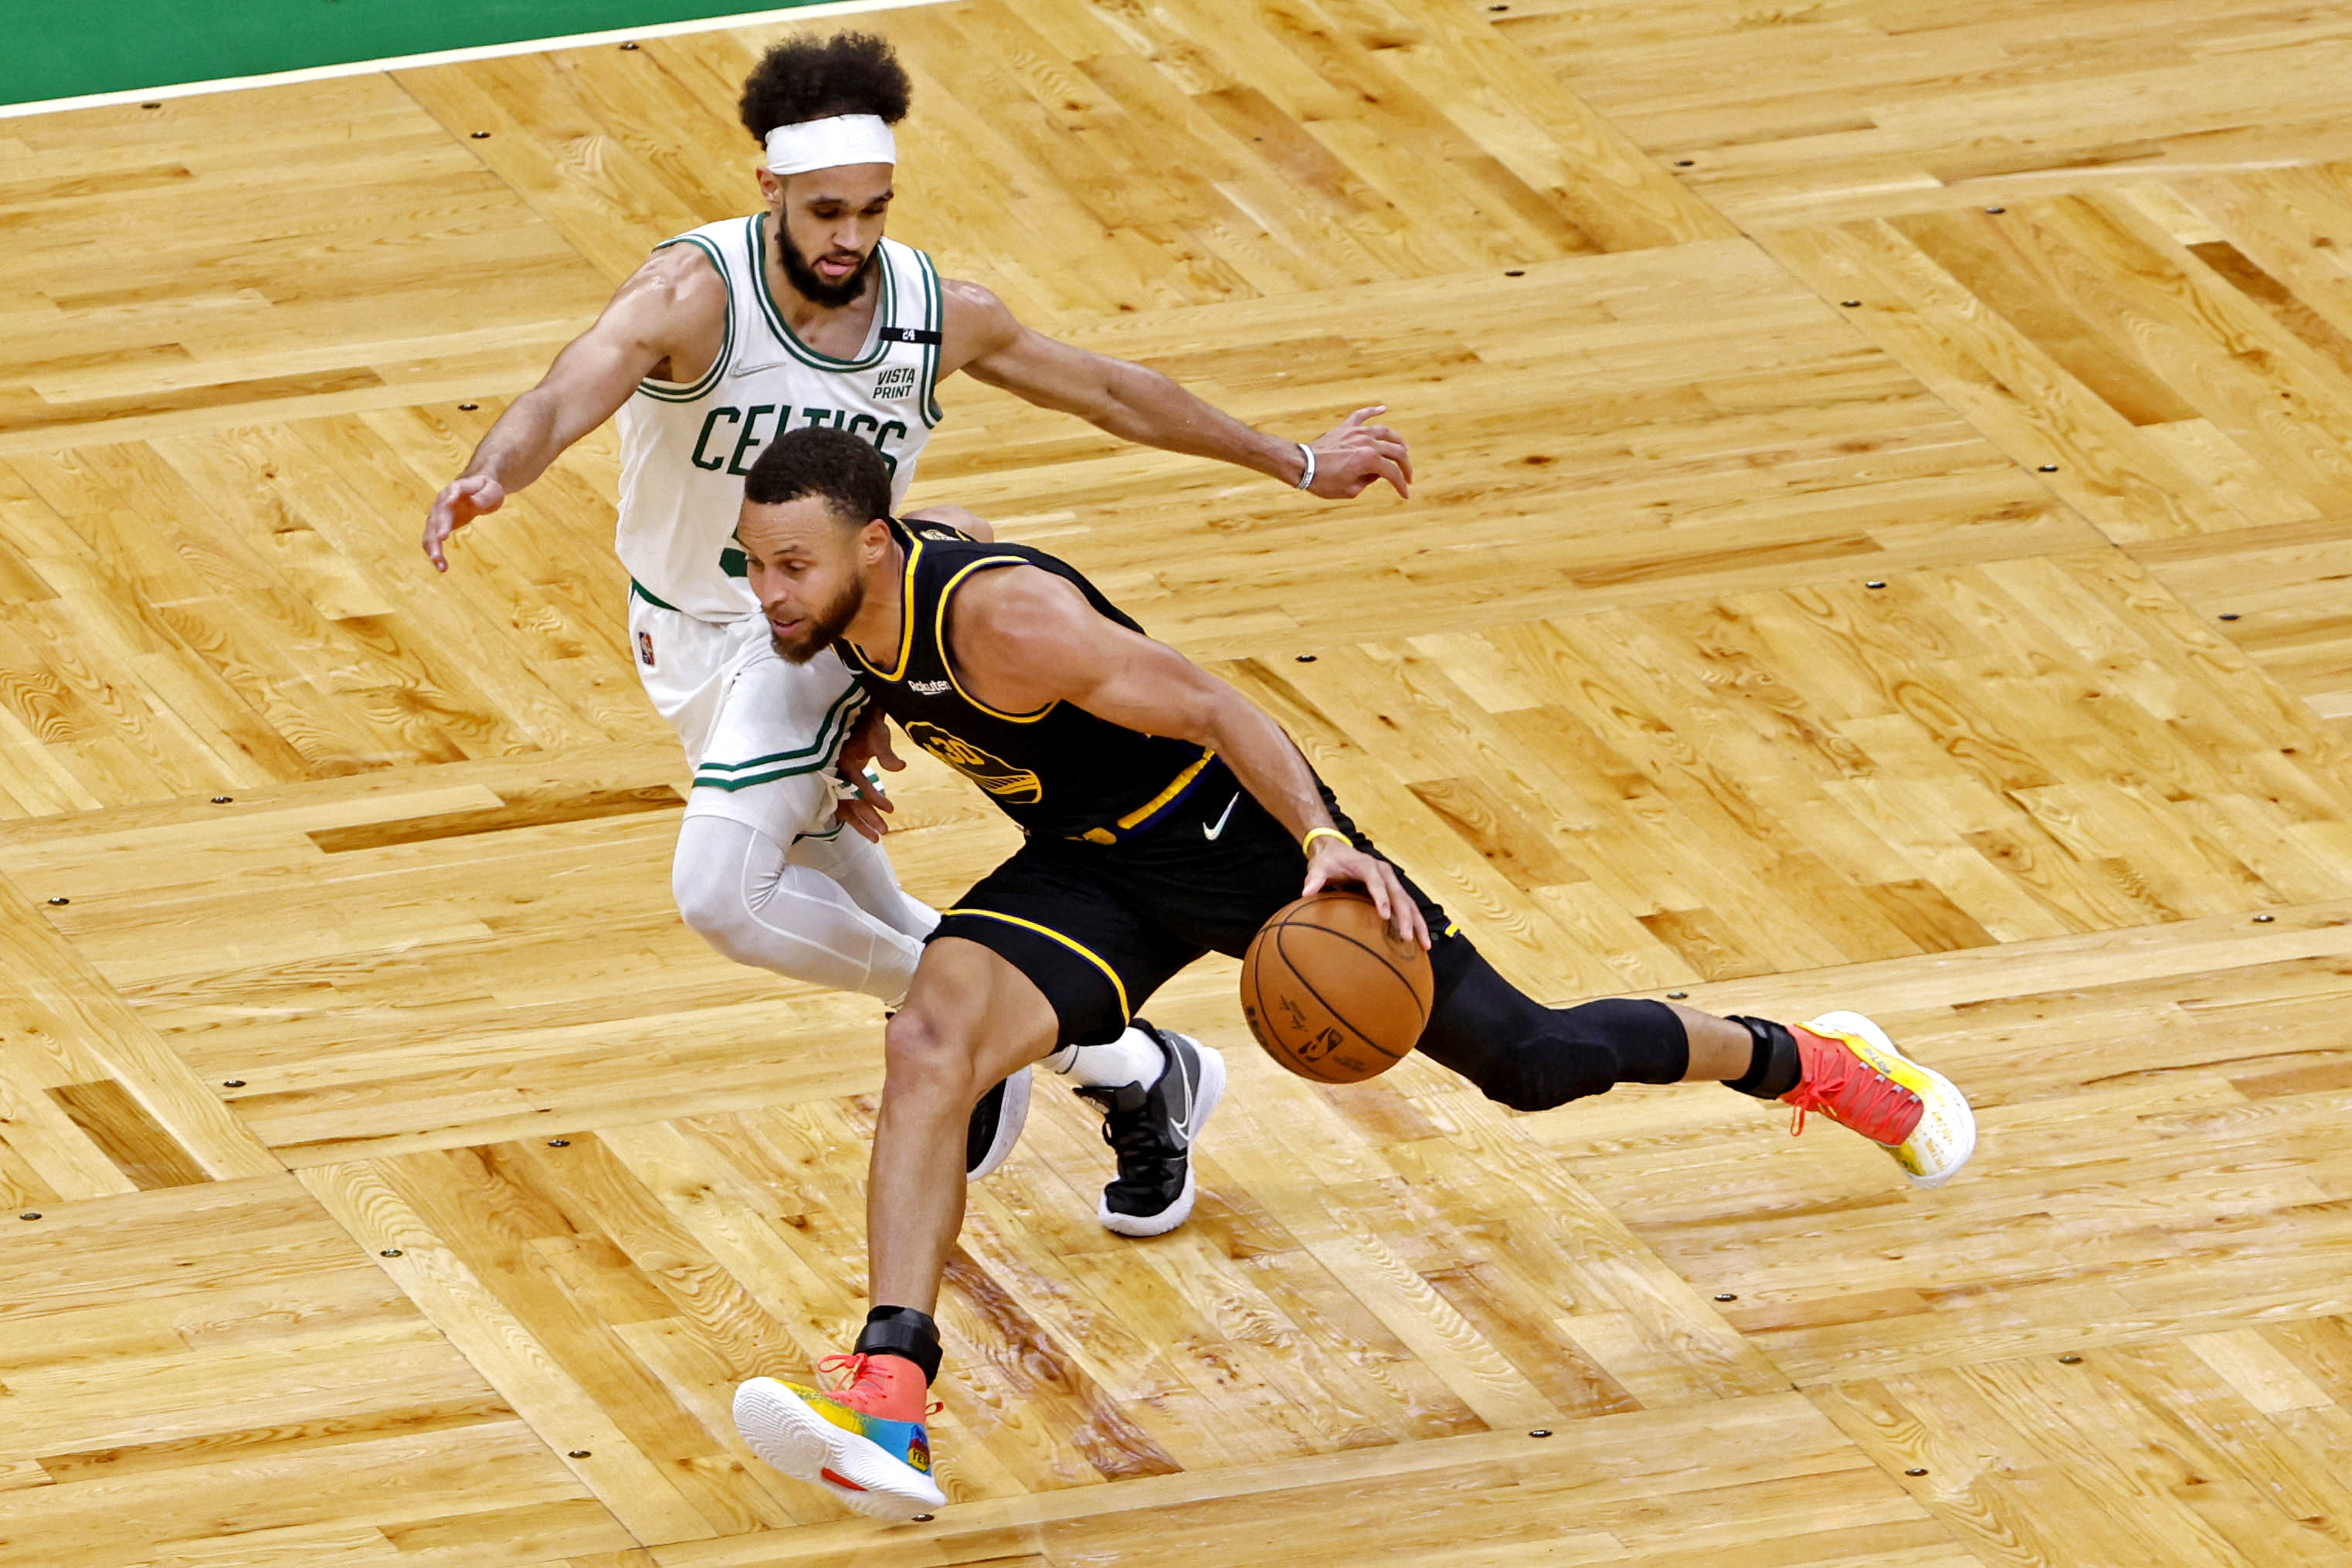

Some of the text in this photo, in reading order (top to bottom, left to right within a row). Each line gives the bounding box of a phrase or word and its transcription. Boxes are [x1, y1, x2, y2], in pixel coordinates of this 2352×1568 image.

[902, 328, 915, 341] 24
[877, 368, 915, 385] VISTA
[872, 385, 913, 399] PRINT
[691, 404, 907, 484] CETS
[908, 680, 952, 694] Rakuten
[929, 736, 985, 765] 30
